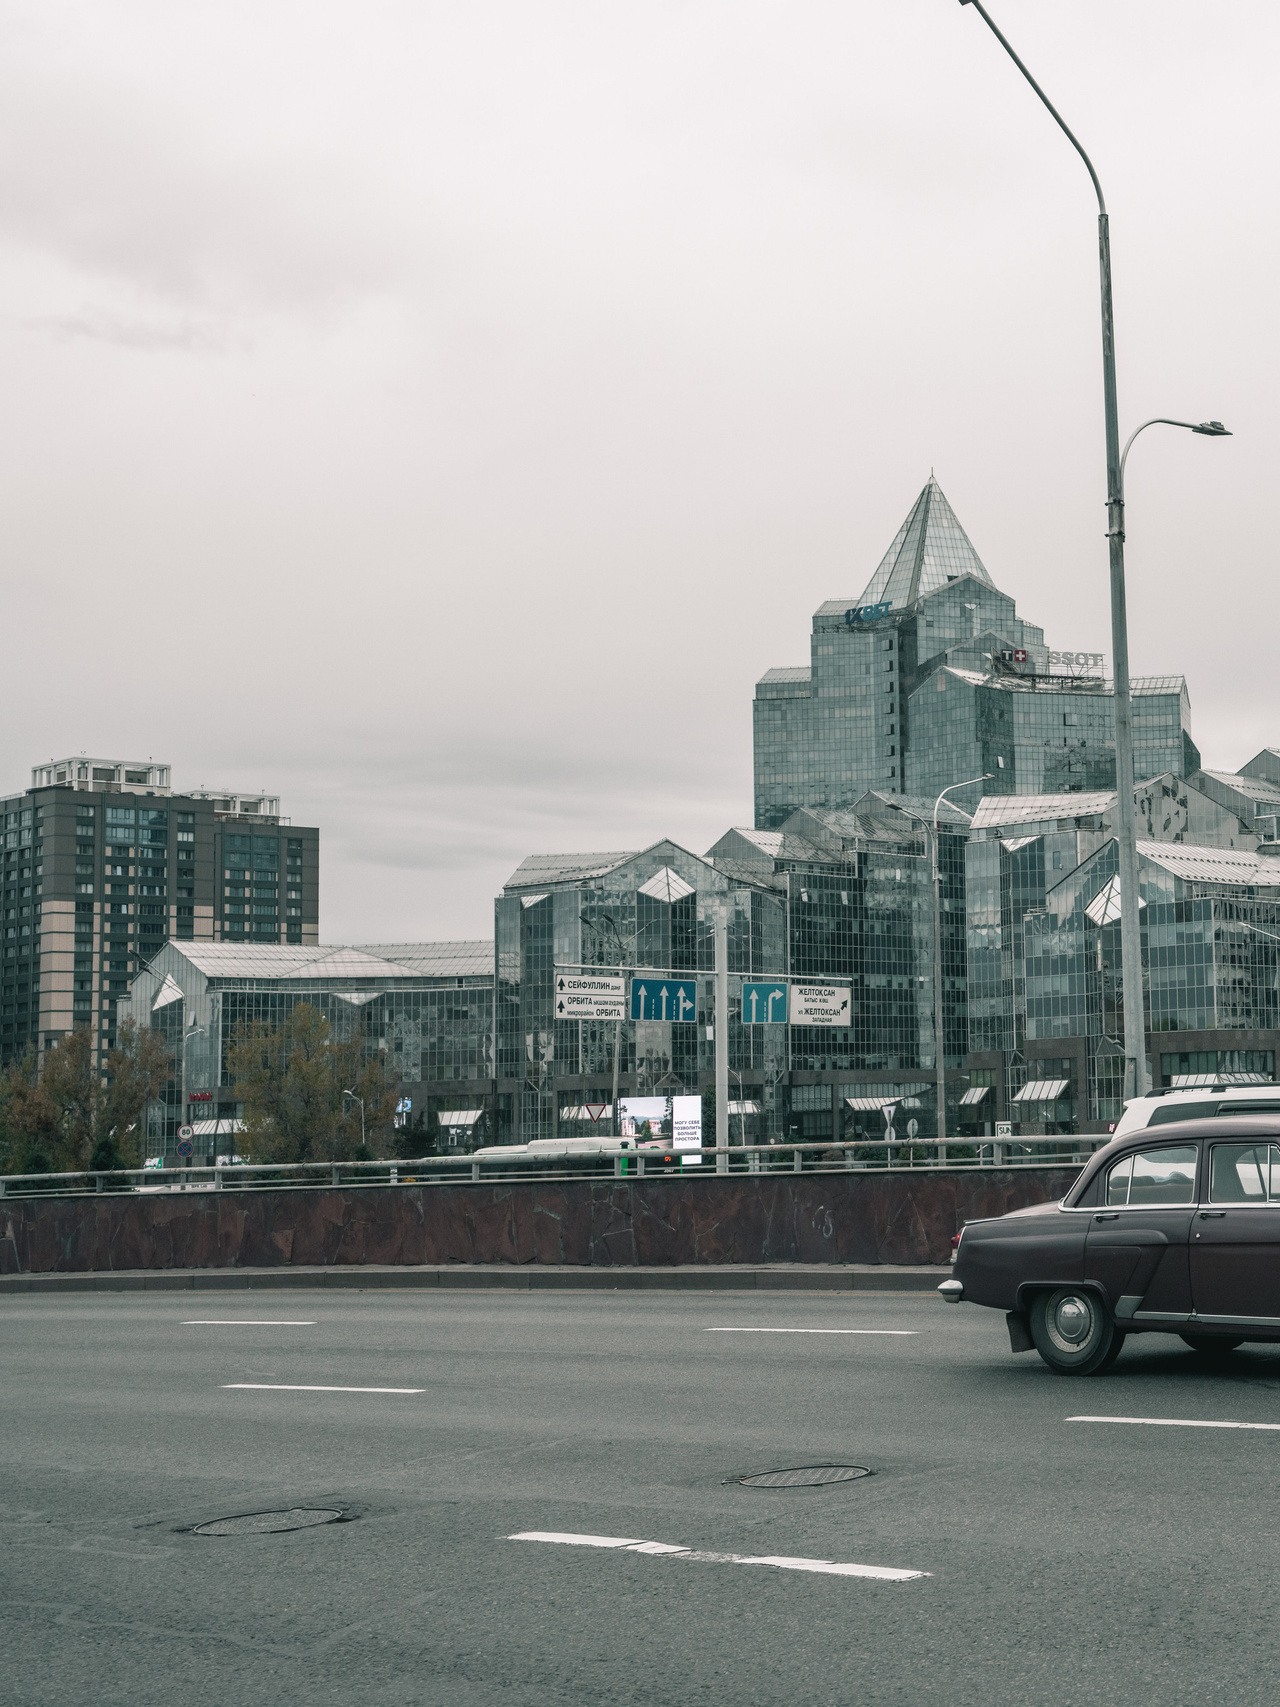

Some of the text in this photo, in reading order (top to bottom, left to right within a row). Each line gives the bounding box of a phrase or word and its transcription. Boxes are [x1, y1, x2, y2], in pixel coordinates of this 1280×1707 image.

[568, 980, 610, 989] СЕЙФУЛЛИН
[798, 988, 835, 997] ЖЕЛТОҚСАН
[567, 996, 592, 1005] ОРБИТА
[596, 1008, 621, 1017] ОРБИТА
[804, 1008, 840, 1016] ЖЕЛТОКСАН
